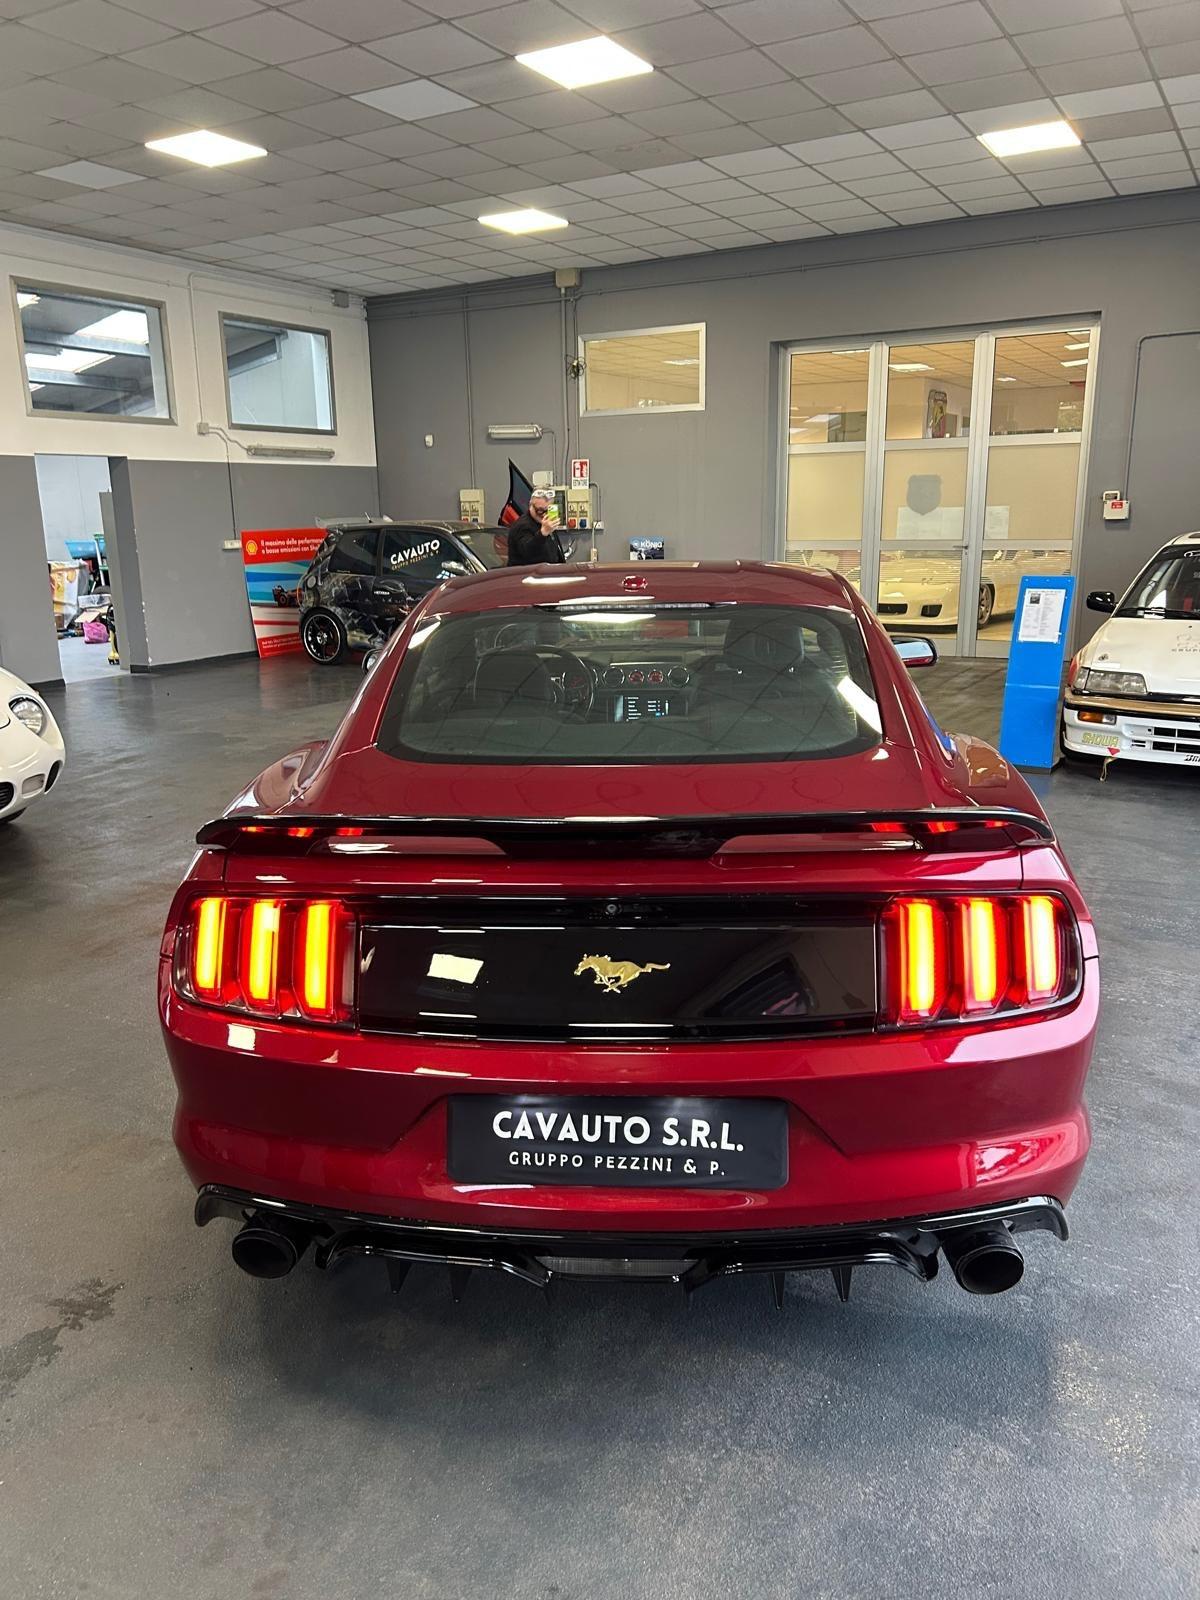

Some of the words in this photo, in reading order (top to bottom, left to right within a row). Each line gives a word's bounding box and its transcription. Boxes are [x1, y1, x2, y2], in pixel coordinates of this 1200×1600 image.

[390, 539, 440, 565] CAVAUTO
[1081, 732, 1119, 747] SHOWA
[492, 1110, 651, 1145] CAVAUTO
[662, 1117, 744, 1152] S.R.L.
[509, 1151, 583, 1168] GRUPPO
[594, 1156, 672, 1173] PEZZINI
[683, 1158, 698, 1175] &
[709, 1161, 726, 1176] P.
